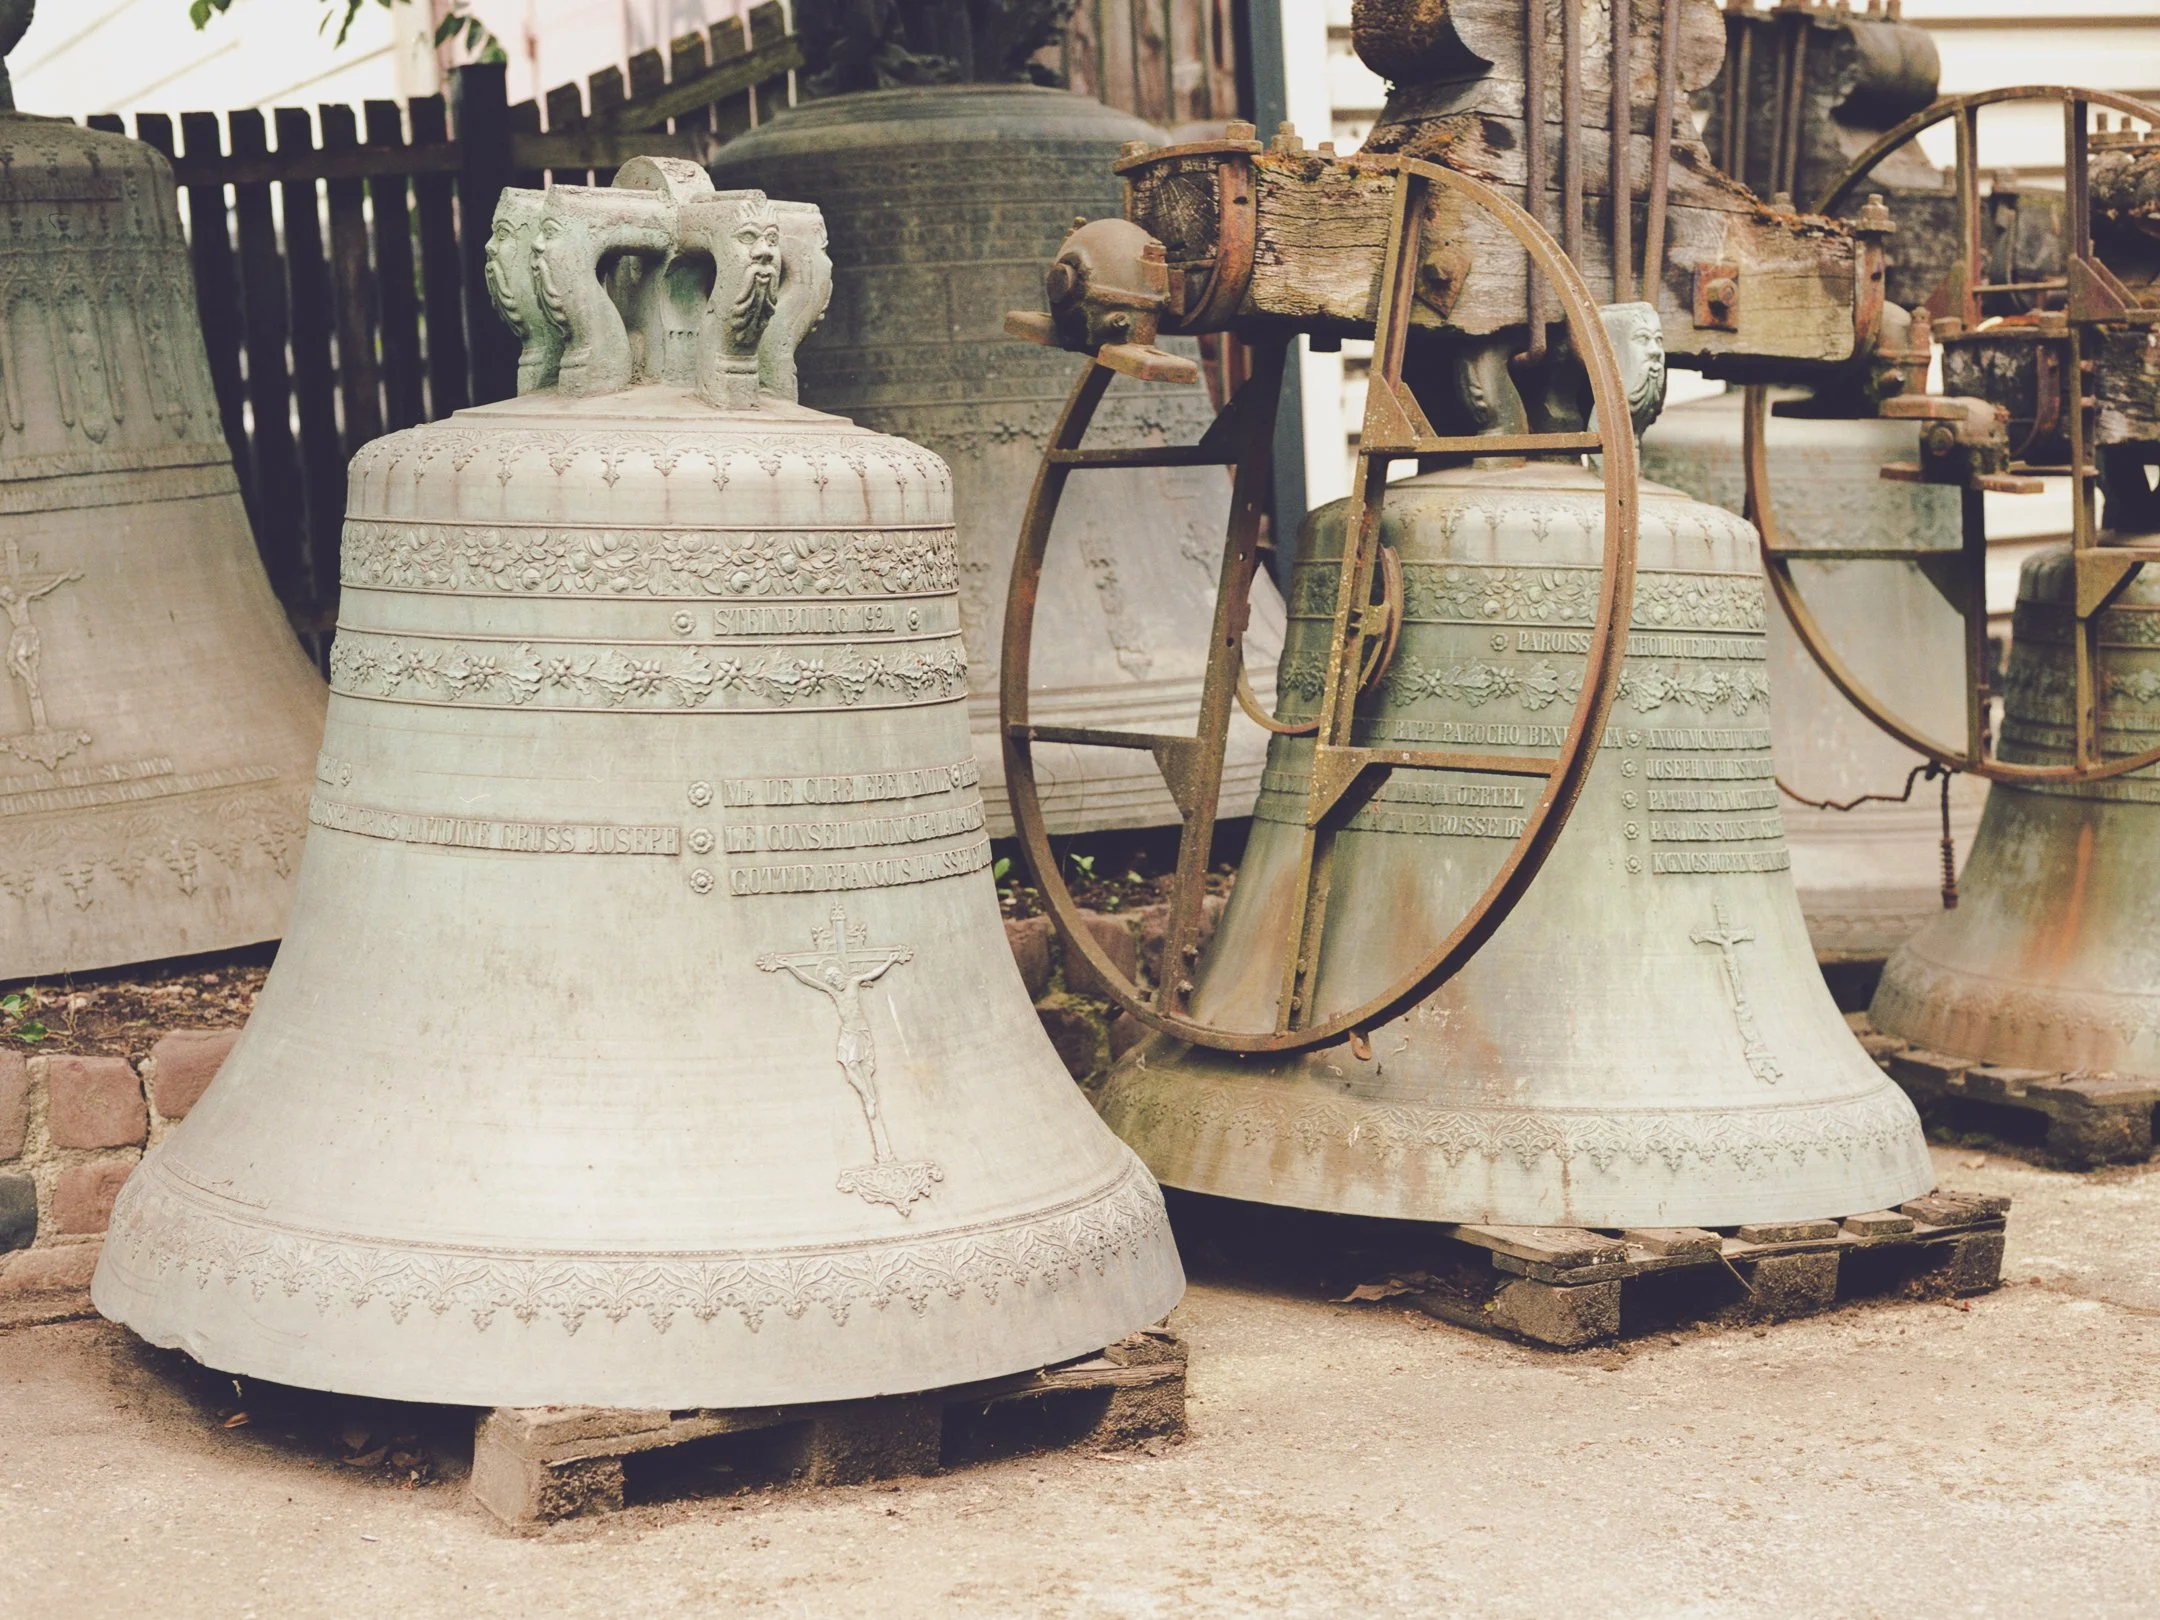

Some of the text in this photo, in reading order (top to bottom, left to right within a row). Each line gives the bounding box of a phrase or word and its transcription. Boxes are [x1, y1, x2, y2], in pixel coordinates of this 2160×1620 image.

[1517, 631, 1592, 653] PAROISS
[1629, 635, 1701, 658] THOLIQUE
[1443, 722, 1520, 745] PAROCHO
[763, 779, 794, 805] LE
[586, 826, 680, 855] JOSEPH
[725, 826, 757, 852] LE
[767, 822, 855, 850] CONSEIL
